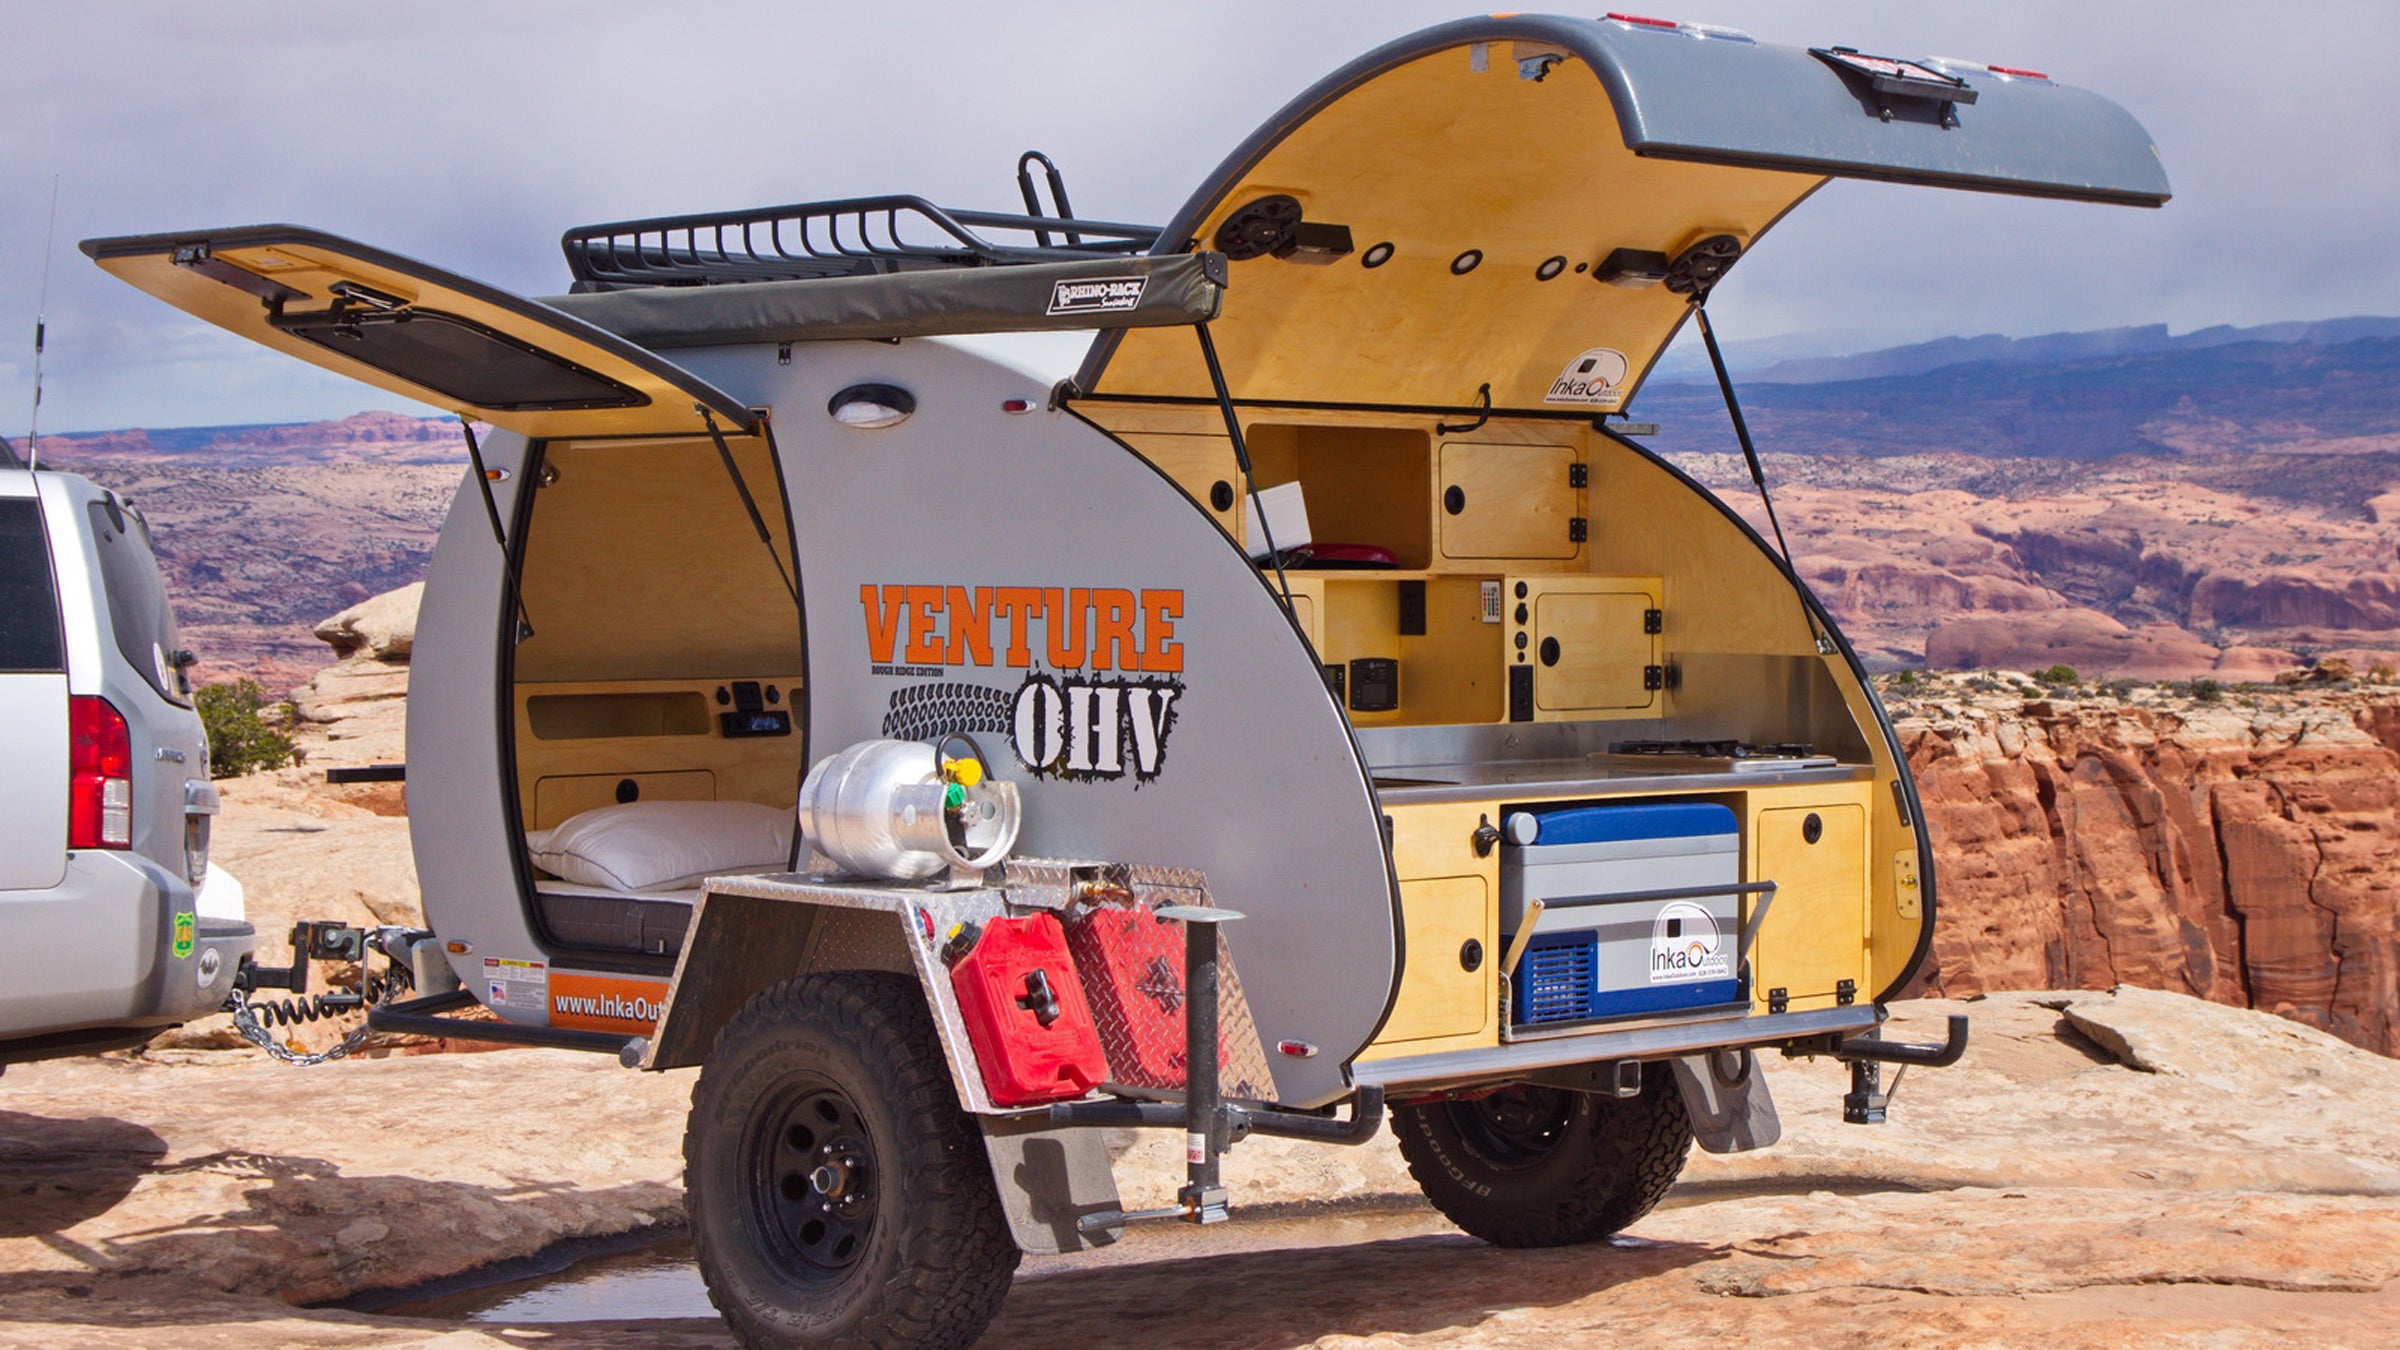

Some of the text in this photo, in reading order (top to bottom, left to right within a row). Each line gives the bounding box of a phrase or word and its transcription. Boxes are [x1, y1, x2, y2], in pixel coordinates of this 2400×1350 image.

[1070, 282, 1141, 299] RHINO-RACK
[860, 584, 1184, 673] VENTURE
[916, 667, 944, 677] EDITION
[1012, 680, 1178, 776] OHV
